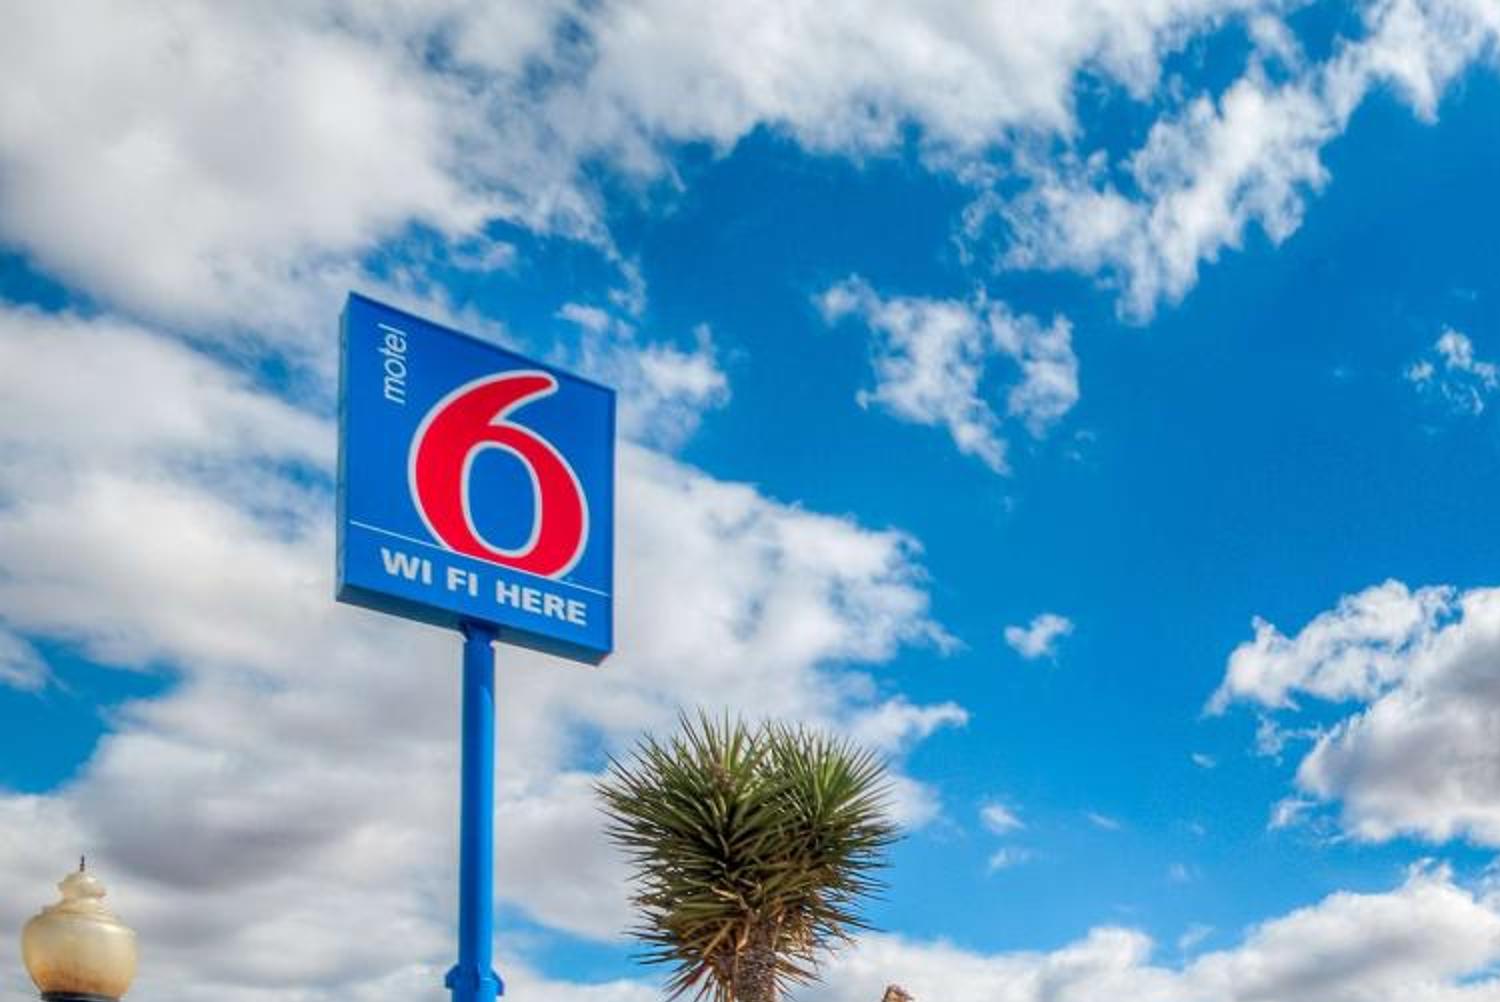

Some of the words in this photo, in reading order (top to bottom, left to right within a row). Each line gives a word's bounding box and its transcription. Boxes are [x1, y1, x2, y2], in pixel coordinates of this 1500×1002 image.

[377, 322, 407, 405] motel
[408, 370, 589, 580] 6
[381, 547, 432, 585] WI
[447, 566, 478, 597] FI
[496, 579, 587, 625] HERE
